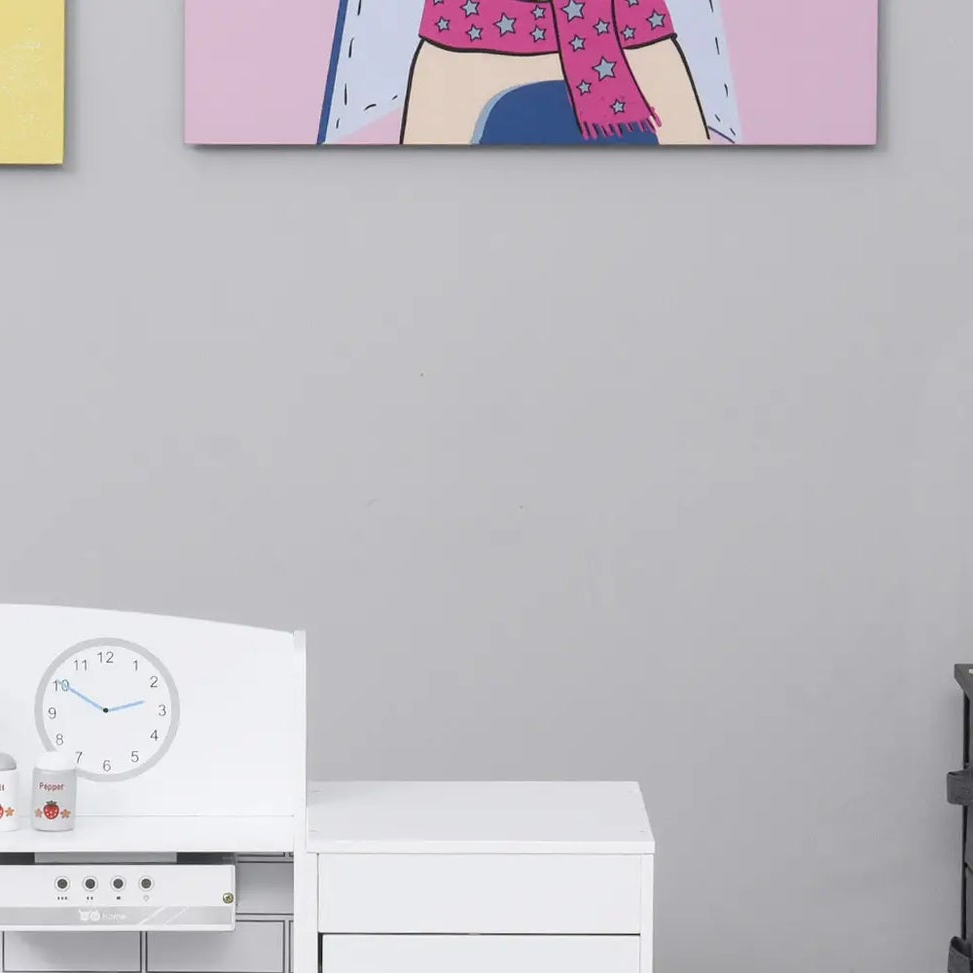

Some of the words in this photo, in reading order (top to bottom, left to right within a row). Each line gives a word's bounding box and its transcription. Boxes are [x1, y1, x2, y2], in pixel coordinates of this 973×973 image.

[97, 651, 114, 664] 12
[73, 659, 88, 671] 11
[132, 659, 139, 671] 1
[53, 679, 69, 692] 10
[150, 675, 159, 688] 2
[48, 707, 57, 720] 9
[158, 704, 167, 717] 3
[55, 733, 64, 746] 8
[150, 729, 159, 741] 4
[75, 751, 83, 764] 7
[131, 750, 139, 763] 5
[102, 759, 111, 772] 6
[39, 782, 64, 792] Pepper
